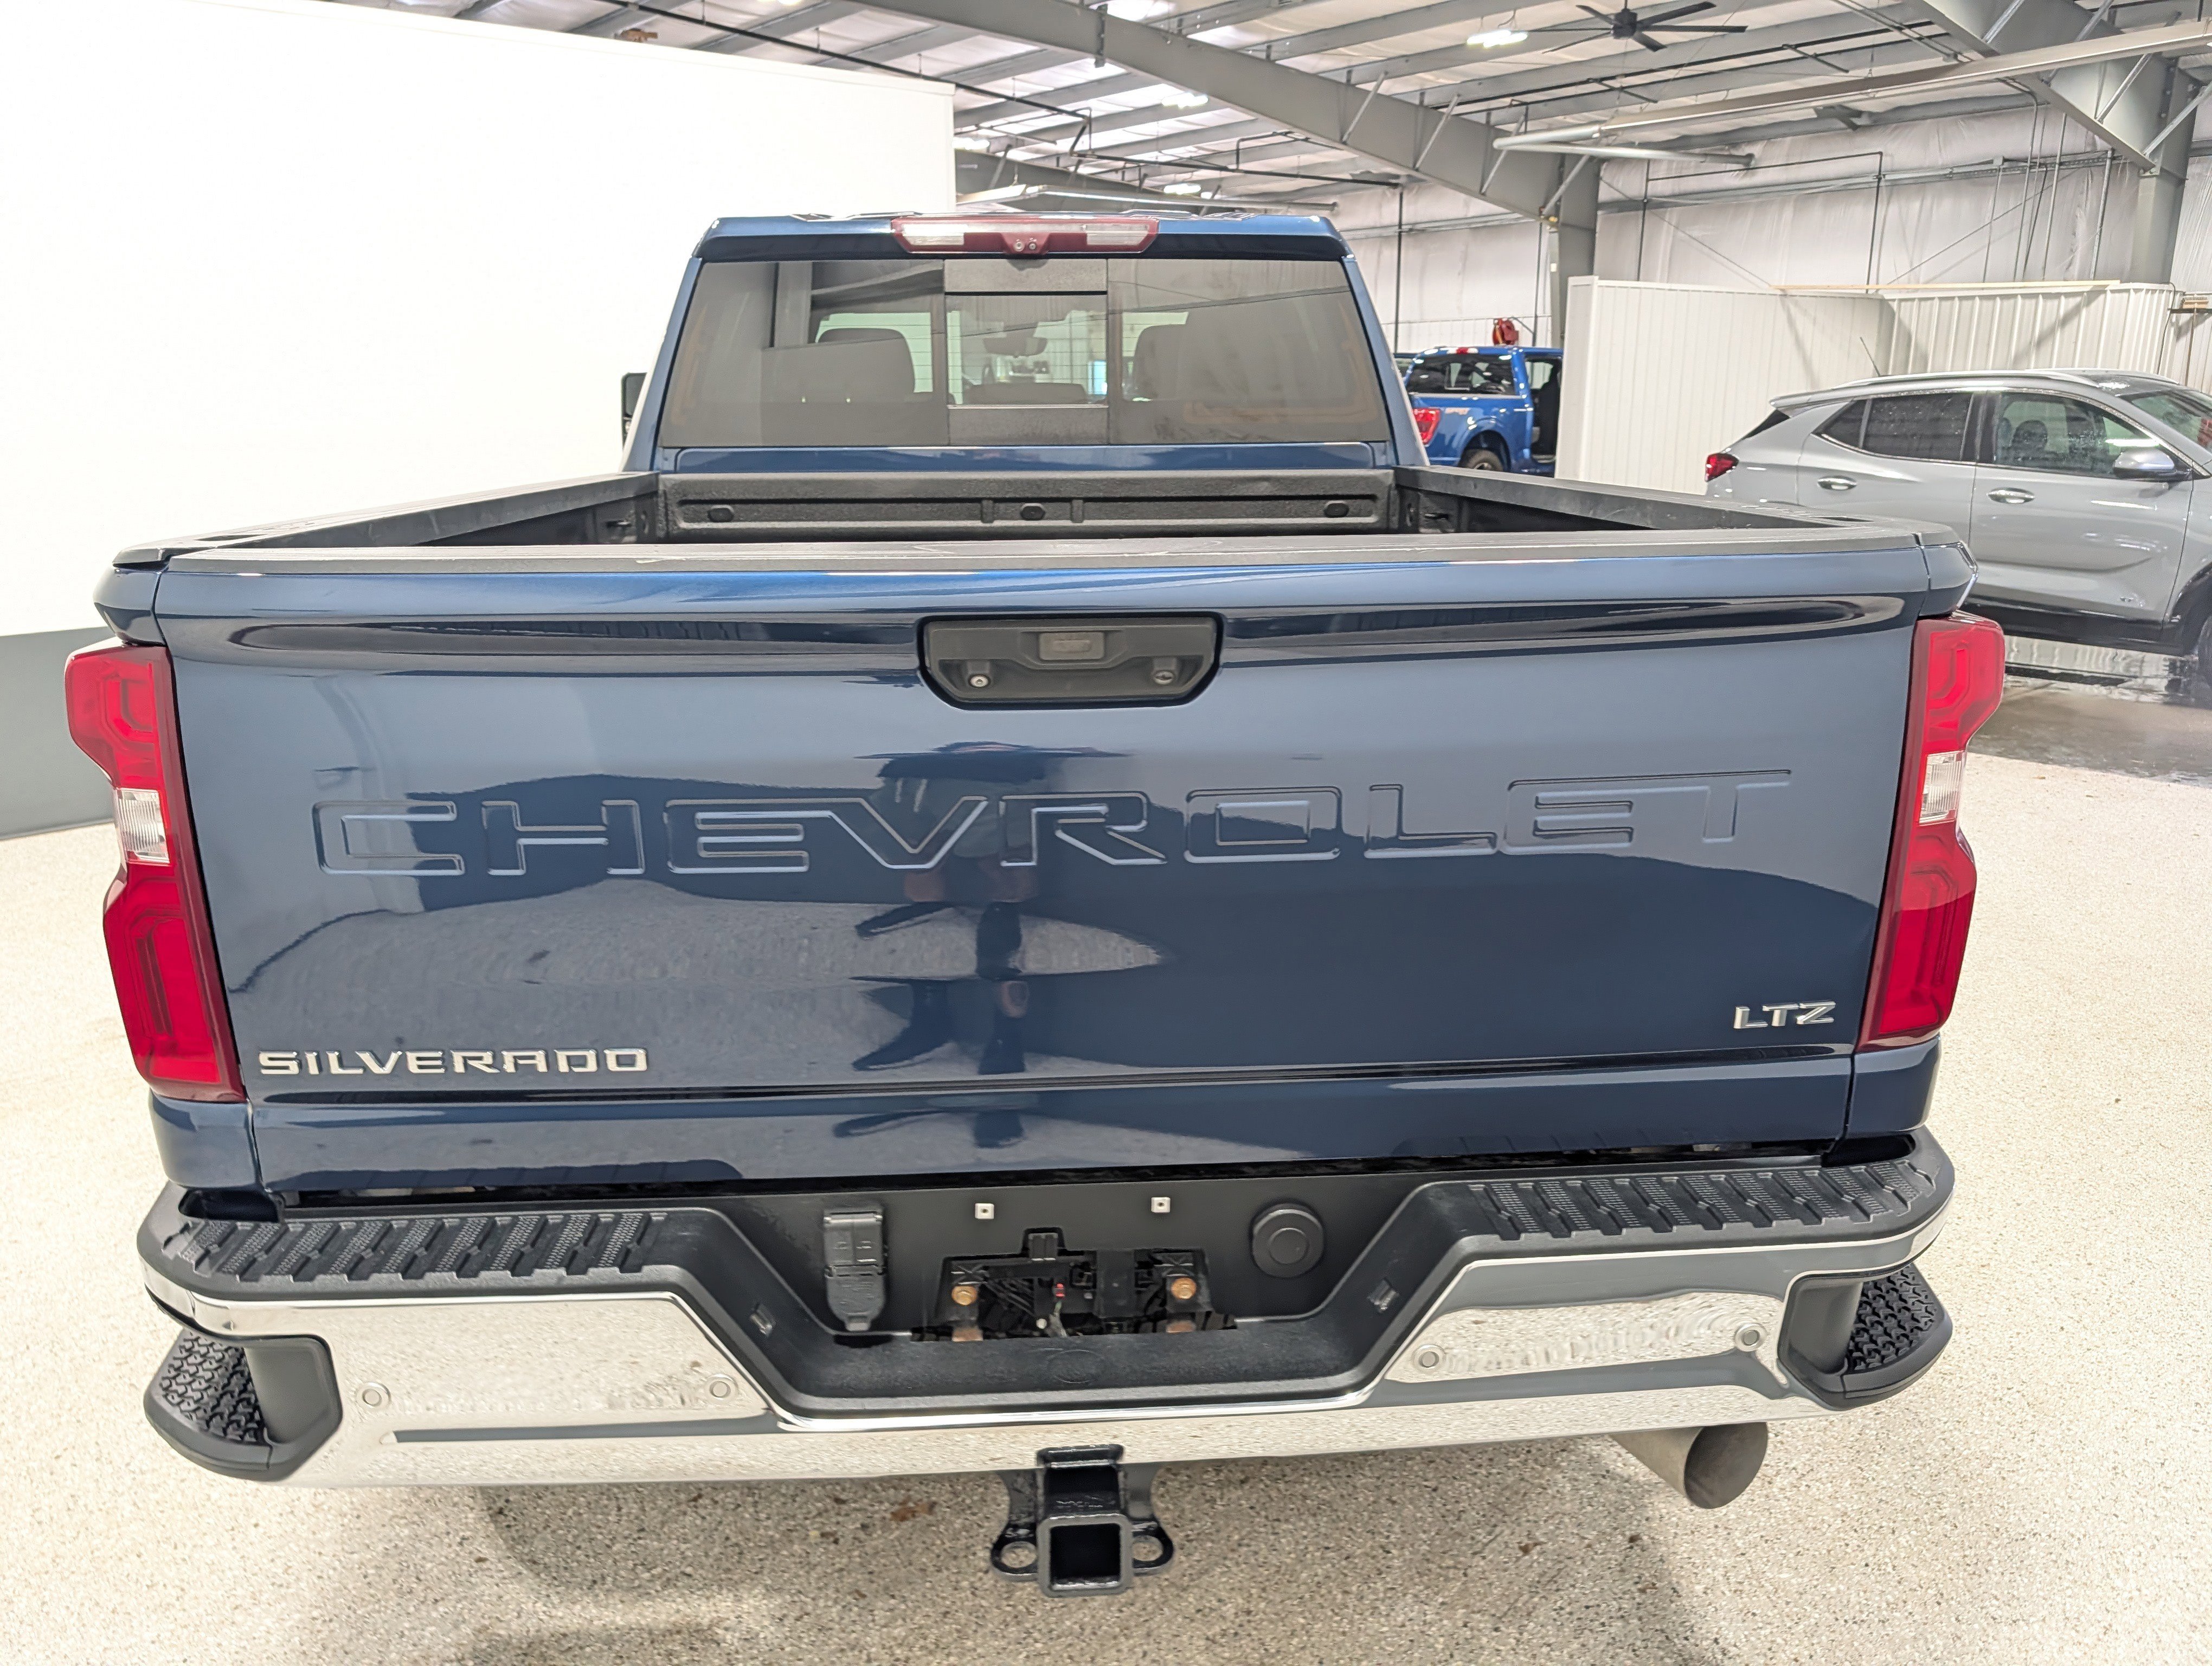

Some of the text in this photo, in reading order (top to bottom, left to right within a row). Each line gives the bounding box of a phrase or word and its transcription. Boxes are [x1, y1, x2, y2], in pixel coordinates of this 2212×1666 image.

[312, 770, 1791, 876] CHEVROLET
[1733, 1001, 1836, 1029] LTZ
[258, 1048, 648, 1075] SILVERADO
